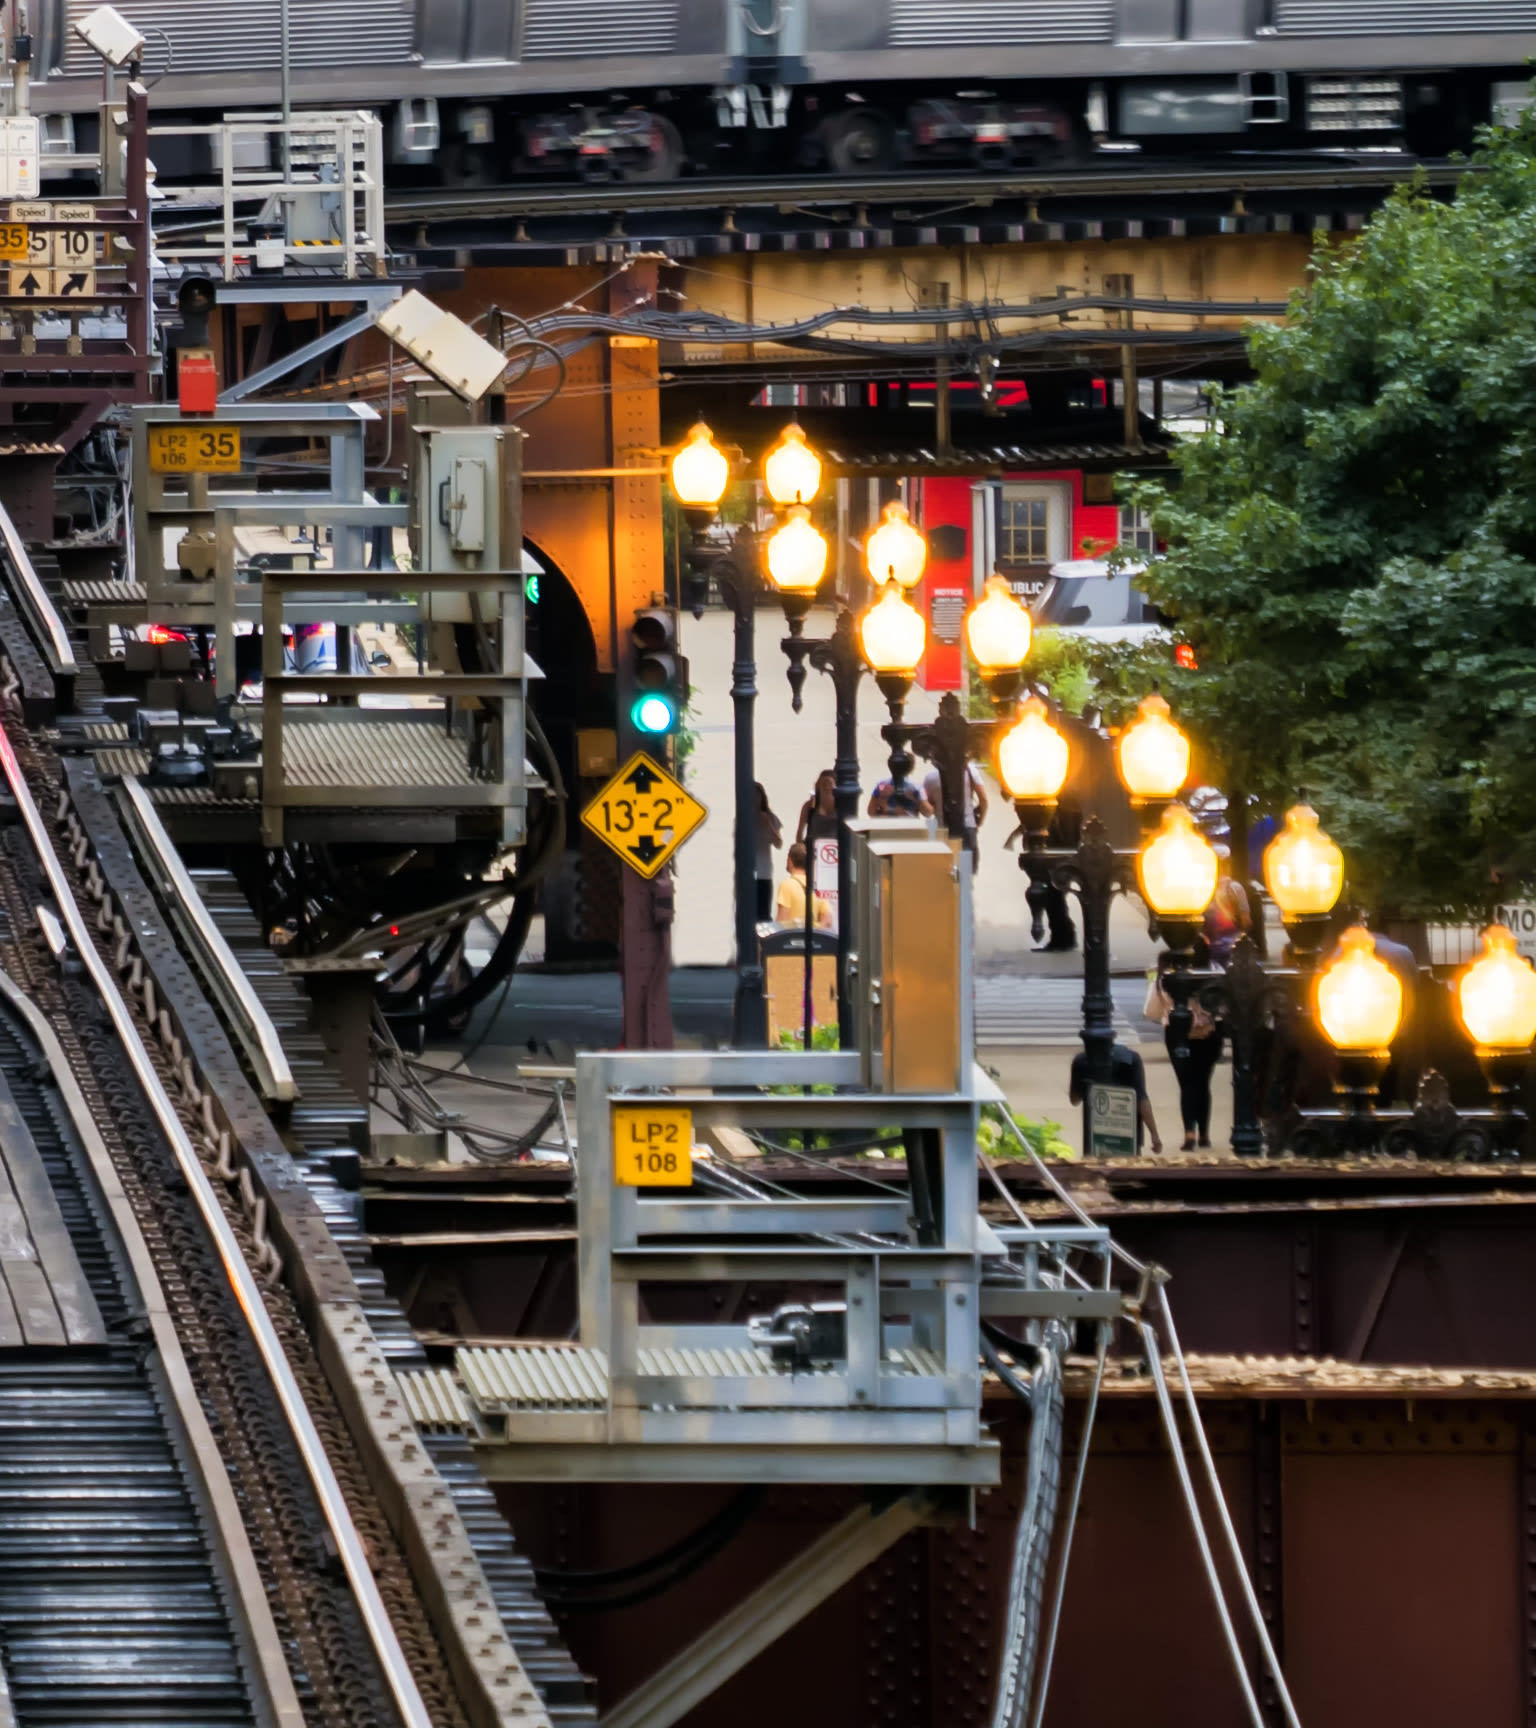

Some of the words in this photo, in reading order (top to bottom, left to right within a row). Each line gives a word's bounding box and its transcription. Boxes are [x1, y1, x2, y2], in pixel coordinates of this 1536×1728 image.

[16, 207, 46, 219] Speed
[59, 209, 90, 221] Speed
[27, 231, 47, 252] 5
[60, 231, 89, 255] 10
[159, 434, 188, 447] LP2
[199, 433, 235, 458] 35
[160, 453, 187, 466] 106
[1009, 581, 1045, 595] UBLIC
[602, 797, 685, 833] 13'-2"
[631, 1122, 679, 1143] LP2
[633, 1152, 678, 1174] 108
